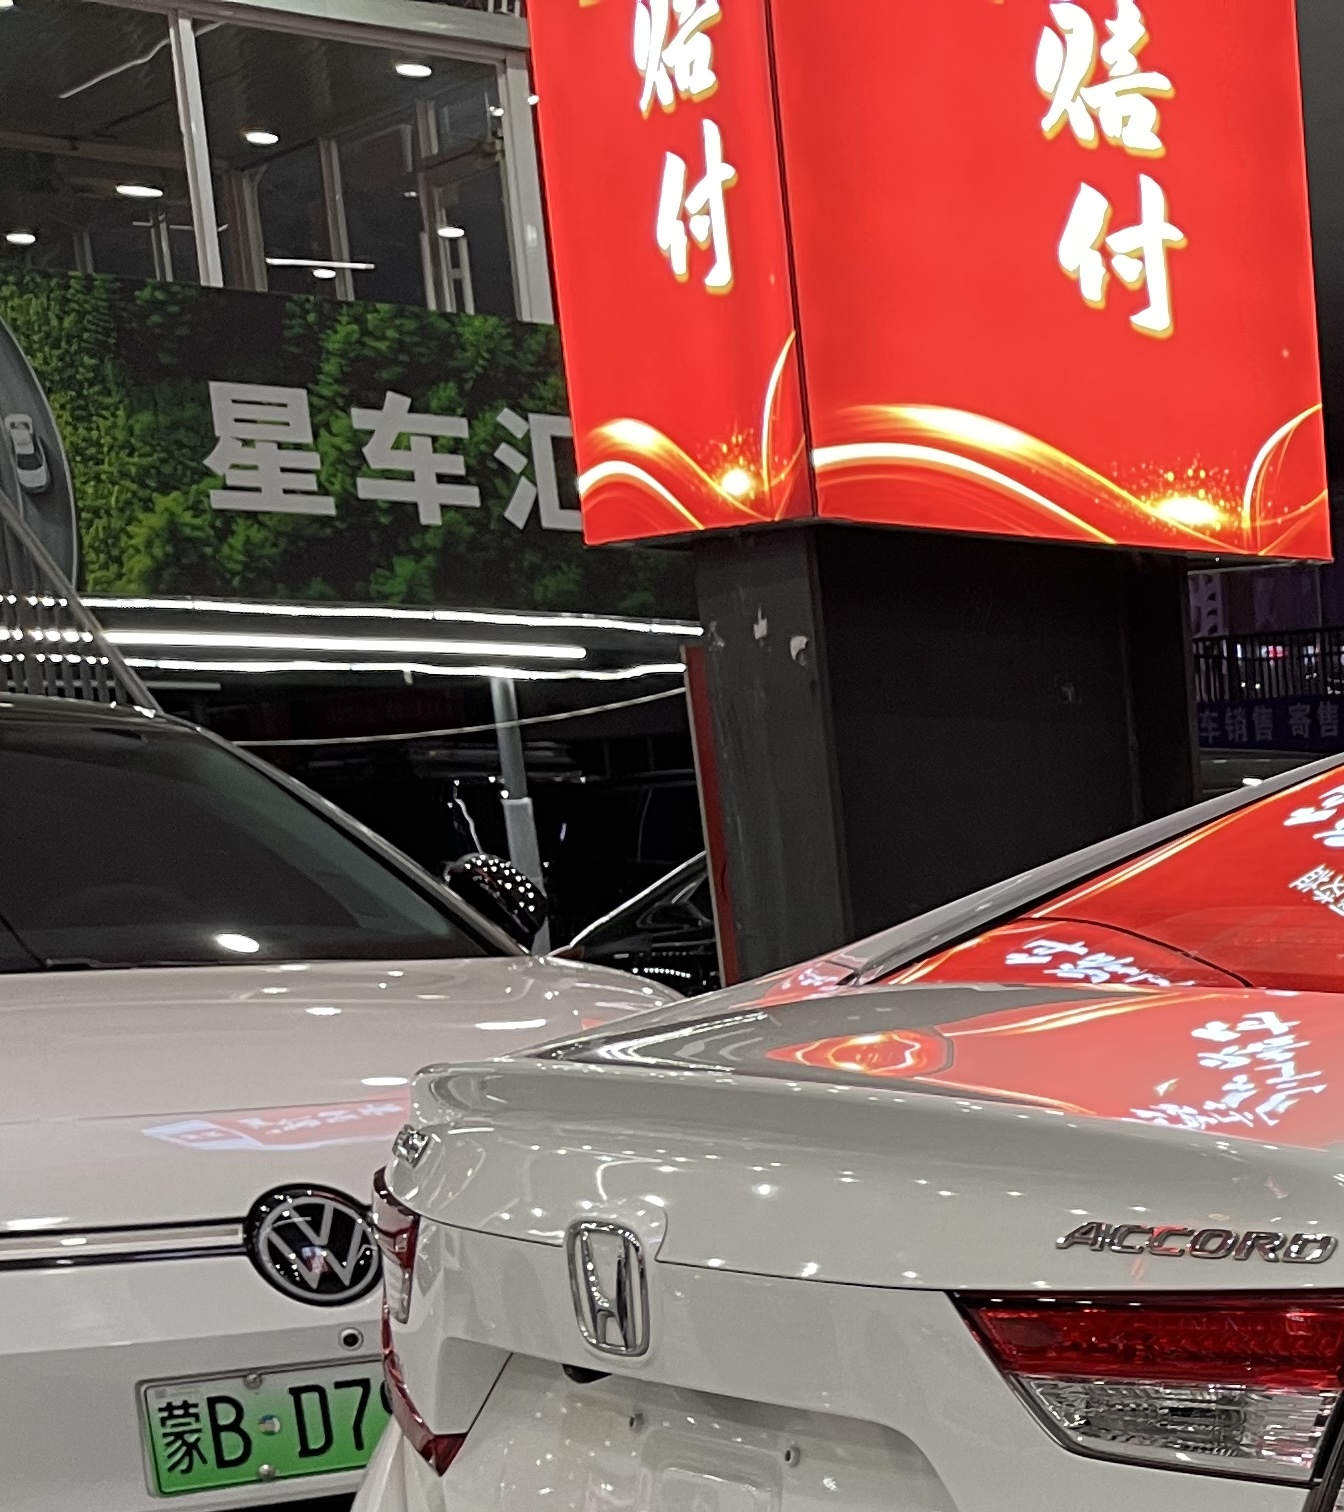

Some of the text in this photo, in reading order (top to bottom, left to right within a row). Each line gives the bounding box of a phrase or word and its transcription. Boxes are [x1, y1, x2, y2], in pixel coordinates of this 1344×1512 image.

[633, 0, 738, 294] 赔付
[1034, 0, 1186, 337] 赔付
[202, 381, 584, 532] 星车汇
[1287, 701, 1340, 740] 寄售
[1055, 1221, 1339, 1264] ACCORD
[157, 1394, 253, 1475] 蒙B
